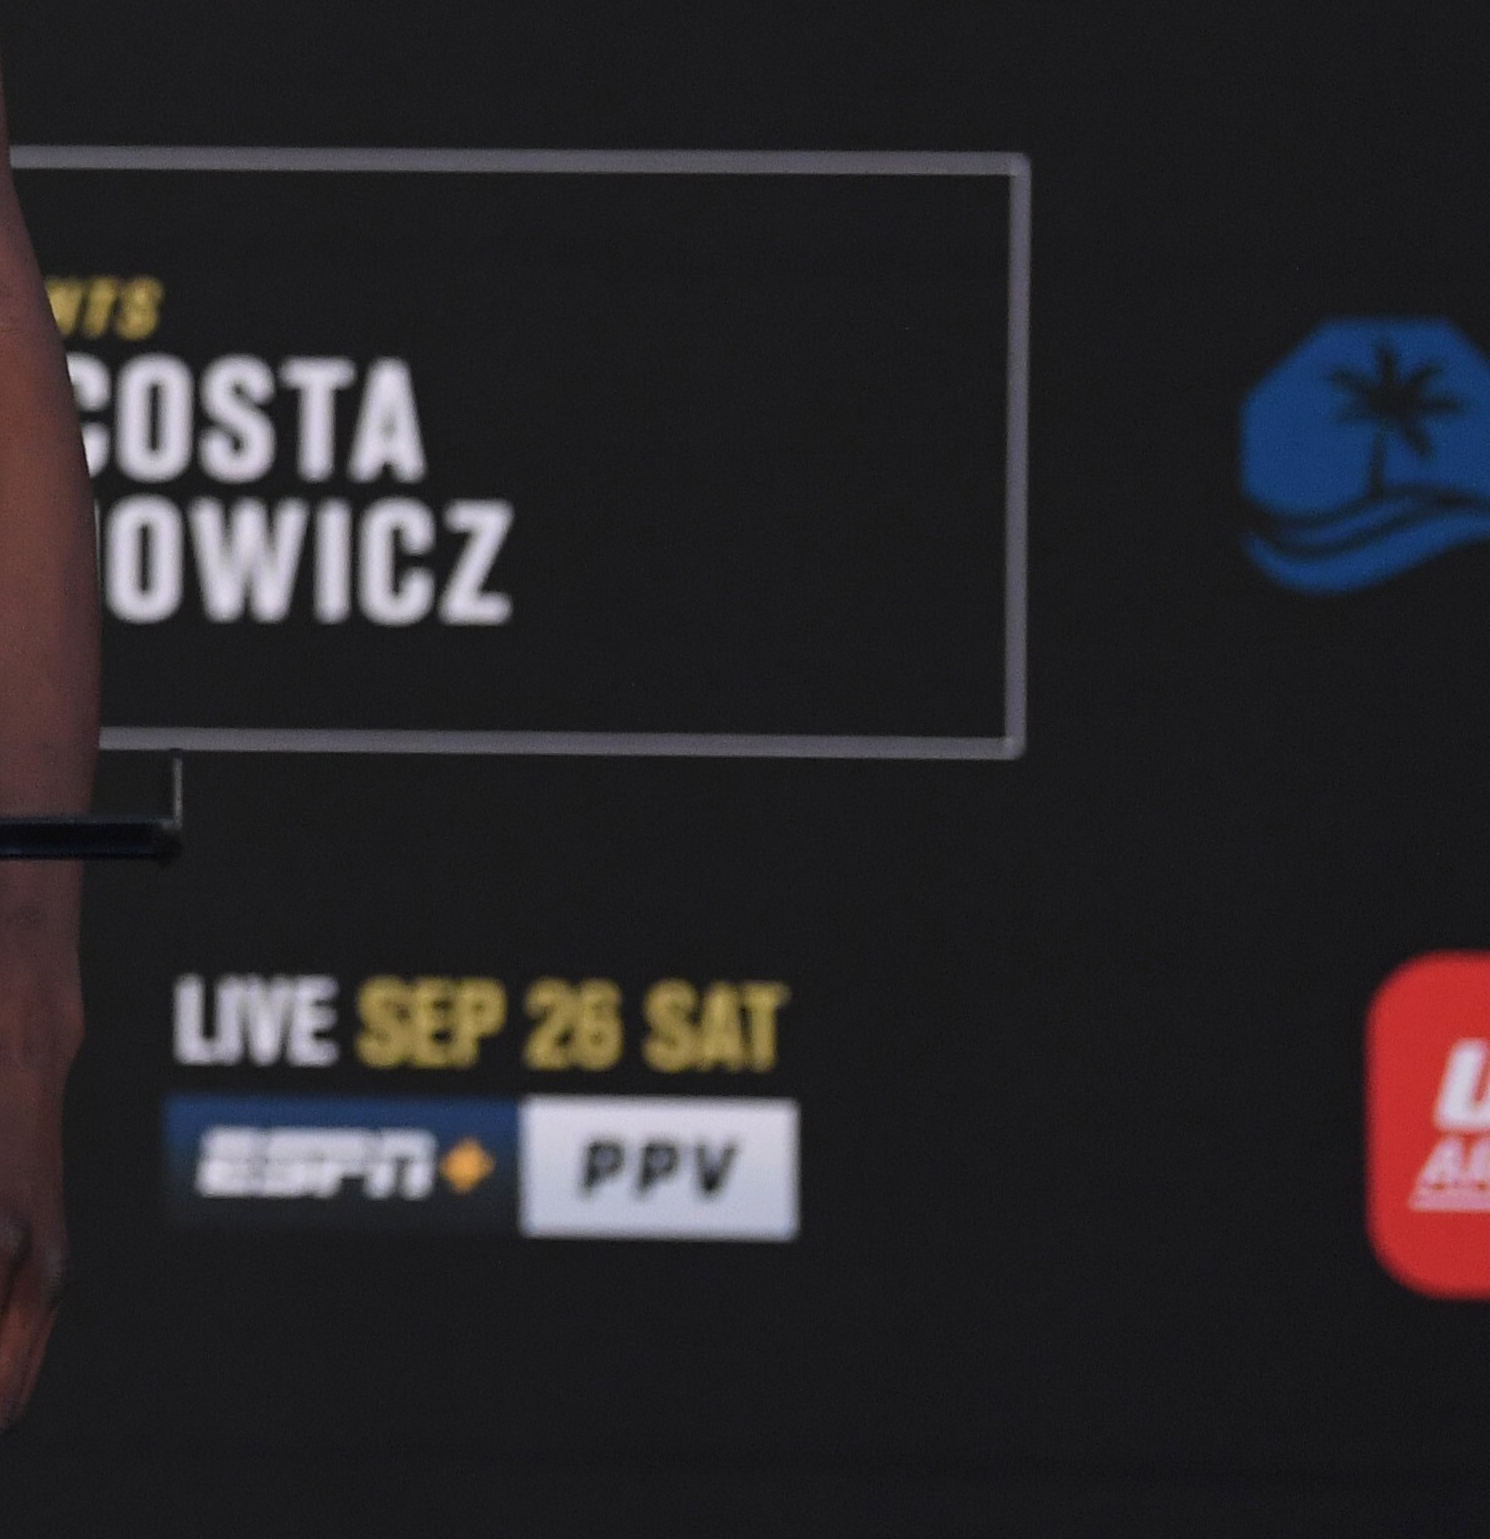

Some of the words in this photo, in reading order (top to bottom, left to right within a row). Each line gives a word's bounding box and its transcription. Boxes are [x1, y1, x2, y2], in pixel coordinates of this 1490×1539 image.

[174, 975, 339, 1067] LIVE
[356, 977, 507, 1068] SEP
[524, 978, 624, 1071] 26
[643, 980, 788, 1072] SAT
[578, 1139, 741, 1200] PPV
